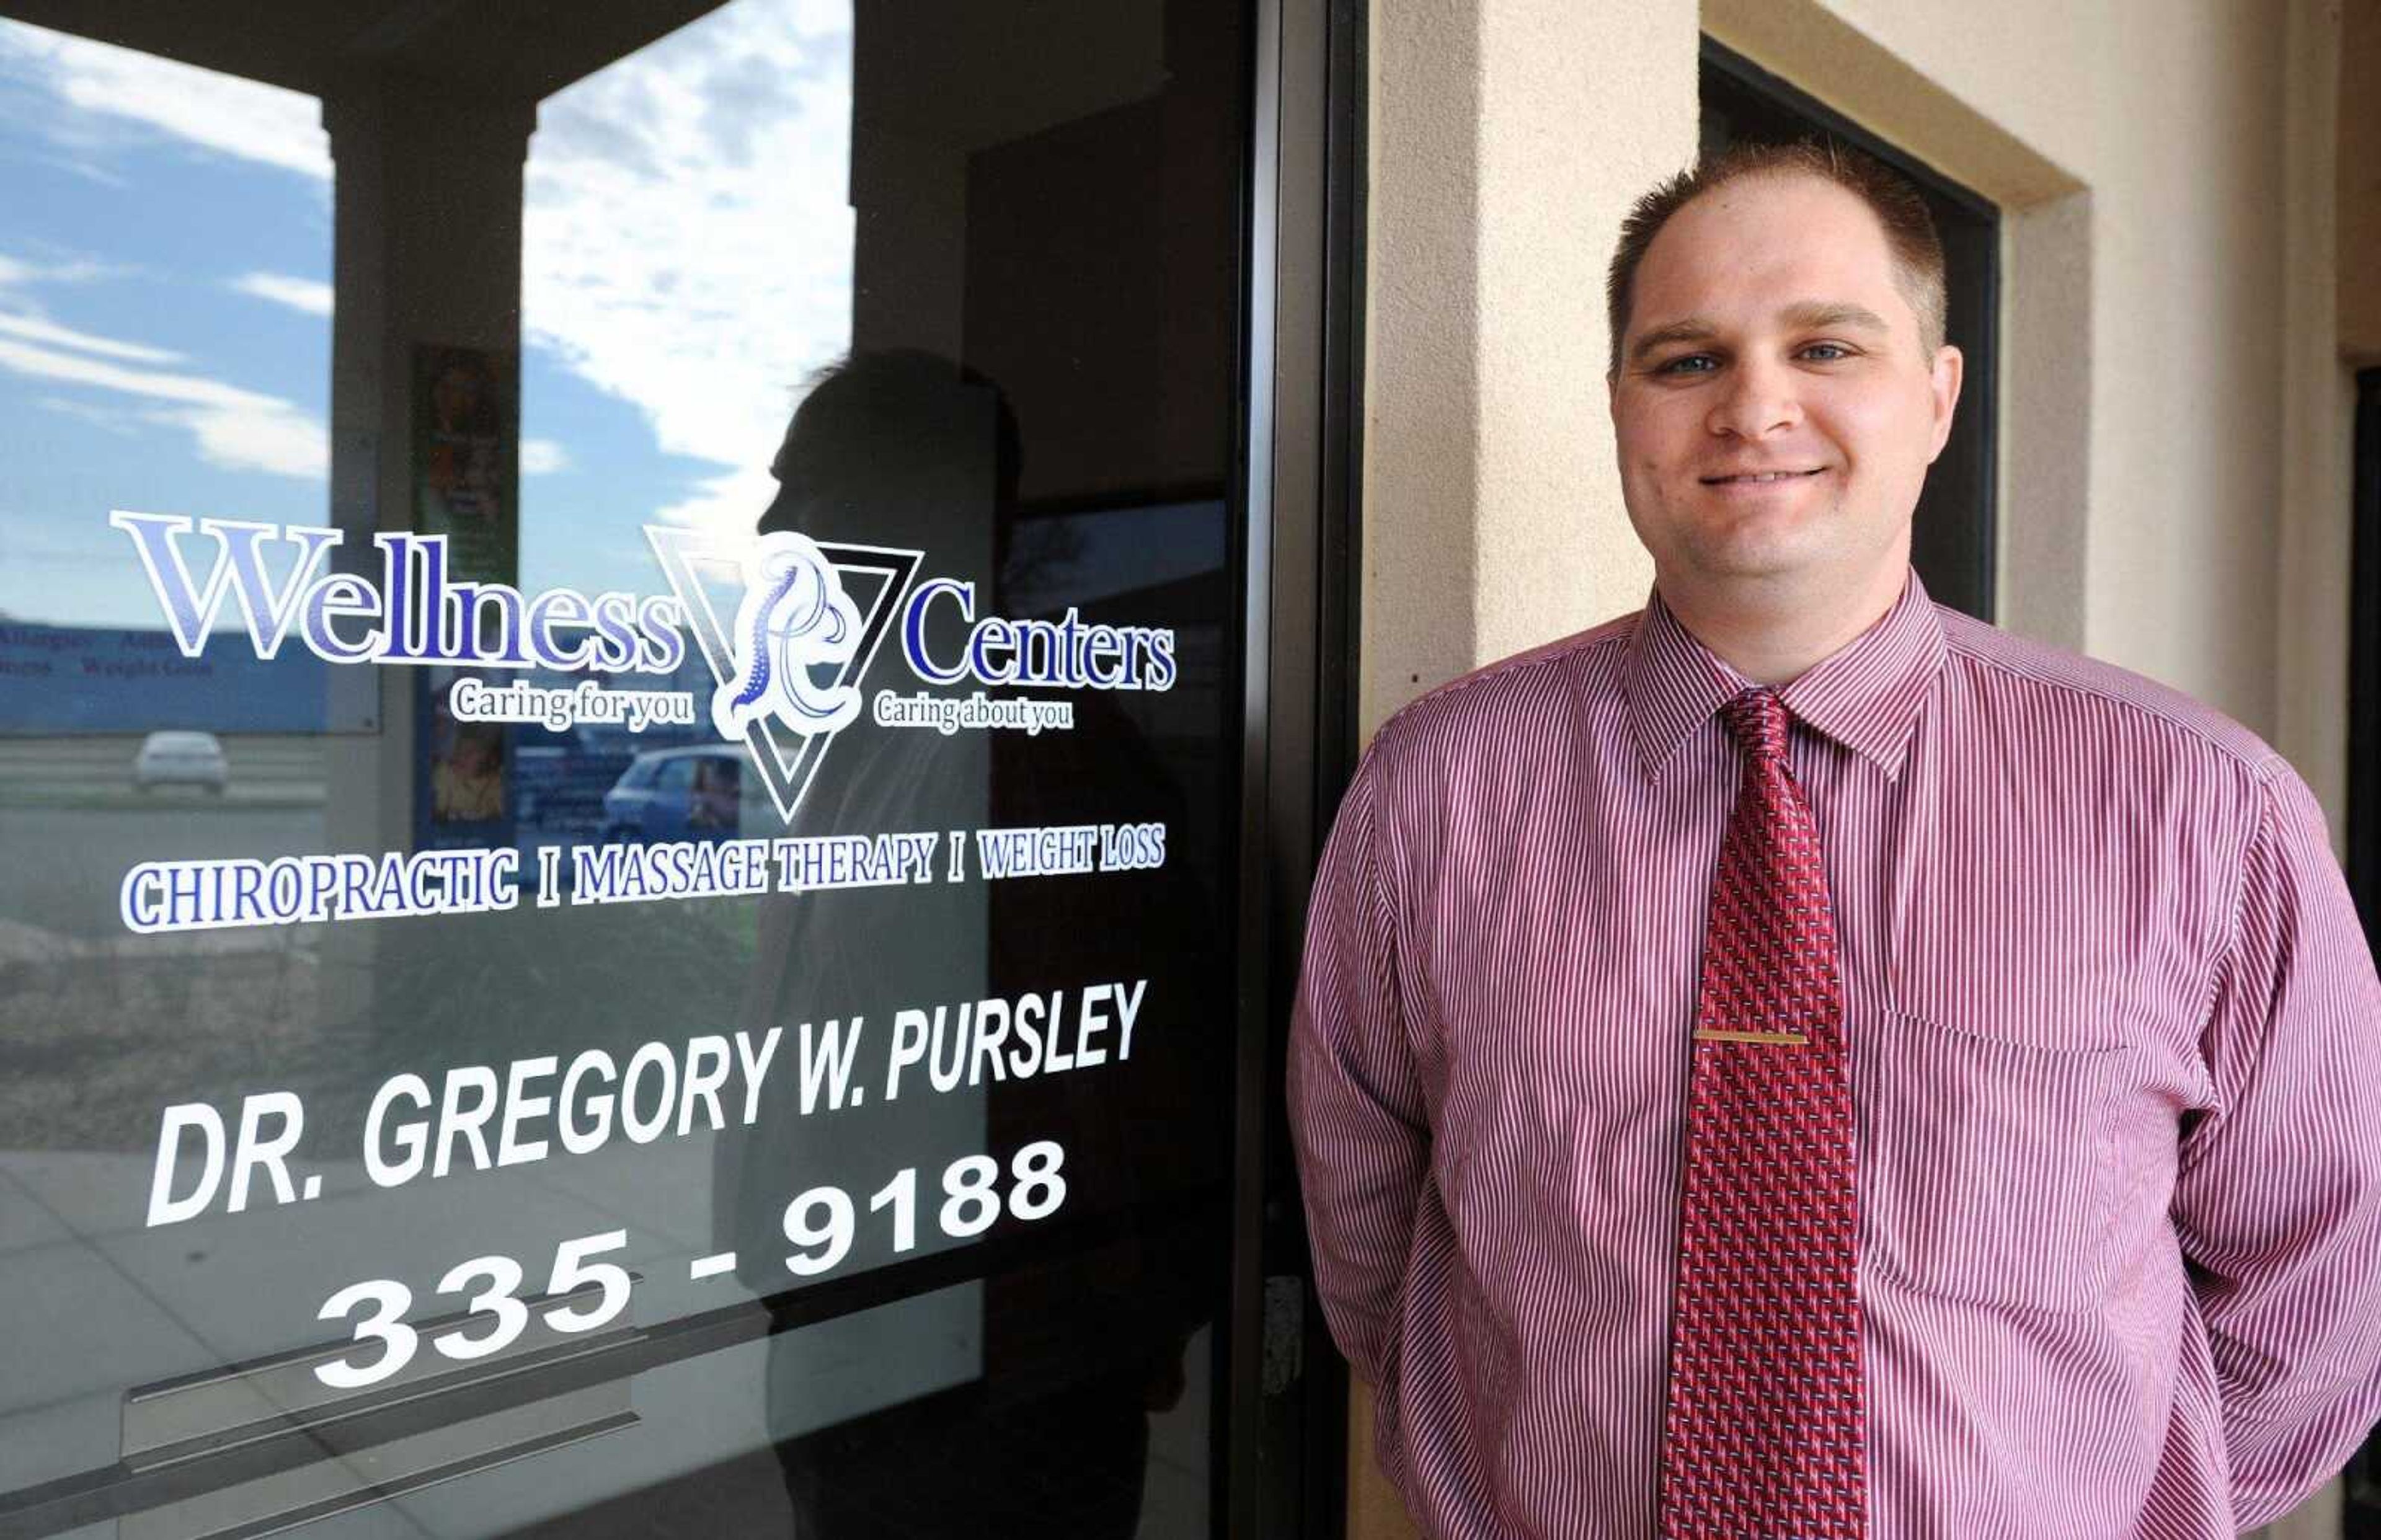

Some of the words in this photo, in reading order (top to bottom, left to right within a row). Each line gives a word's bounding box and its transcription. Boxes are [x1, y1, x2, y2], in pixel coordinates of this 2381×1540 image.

[110, 511, 685, 674] Wellness
[902, 578, 1177, 691] Centers
[453, 681, 574, 729] Caring
[576, 682, 625, 722] for
[628, 692, 692, 730] you
[876, 691, 957, 732] Caring
[963, 693, 1029, 727] about
[1033, 701, 1072, 734] you
[124, 850, 517, 931] CHIROPRACTIC
[573, 841, 767, 903] MASSAGE
[775, 834, 936, 890] THERAPY
[980, 828, 1096, 878] WEIGHT
[1100, 823, 1166, 870] LOSS
[148, 1092, 322, 1226] DR.
[365, 1028, 783, 1187] GREGORY
[801, 1017, 864, 1114] W.
[887, 981, 1146, 1099] PURSLEY
[315, 1229, 630, 1387] 335
[784, 1142, 1066, 1275] 9188
